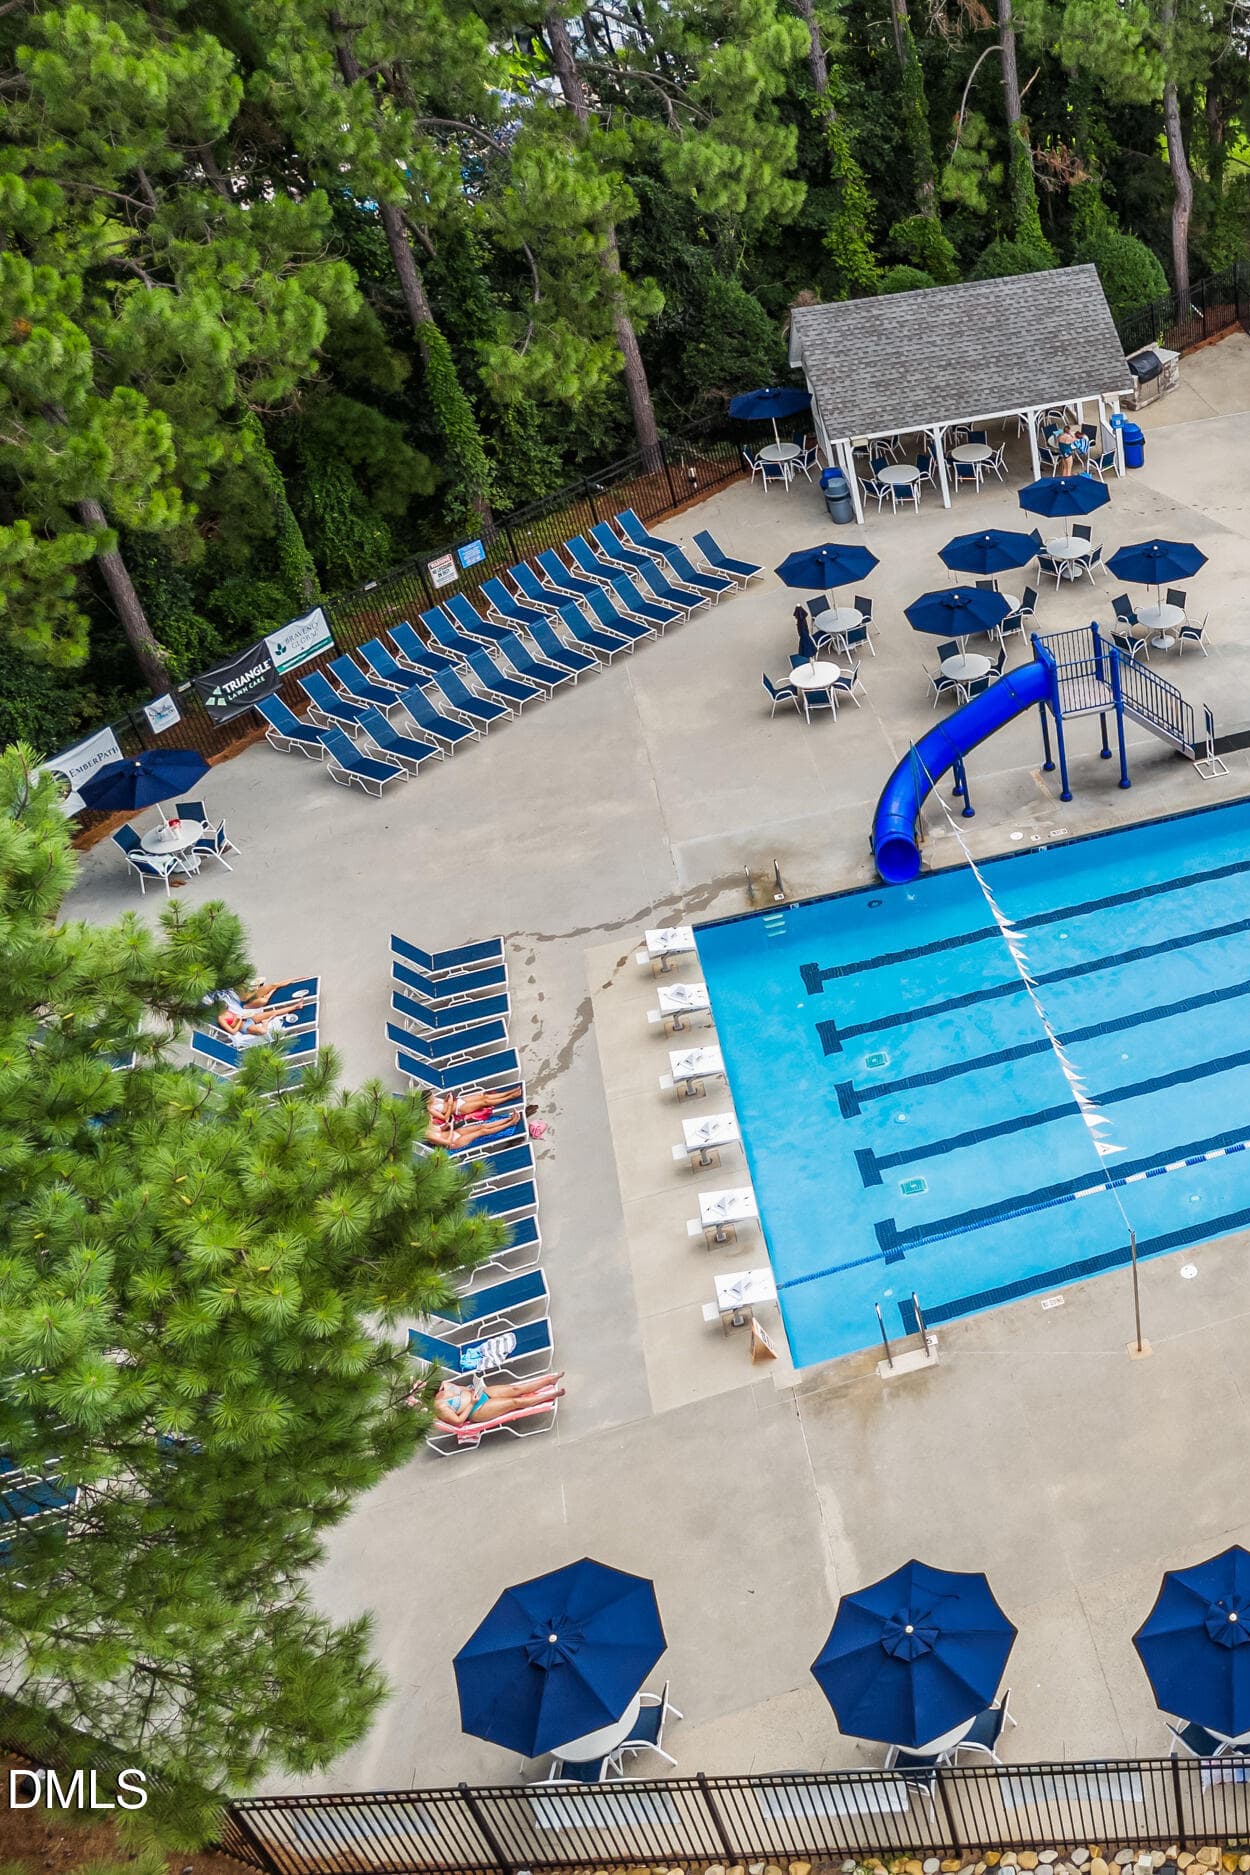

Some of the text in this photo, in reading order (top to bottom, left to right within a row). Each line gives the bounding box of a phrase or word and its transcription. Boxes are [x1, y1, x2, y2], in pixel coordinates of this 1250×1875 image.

[222, 660, 272, 694] TRIANGLE
[228, 676, 266, 701] LAWN CARE
